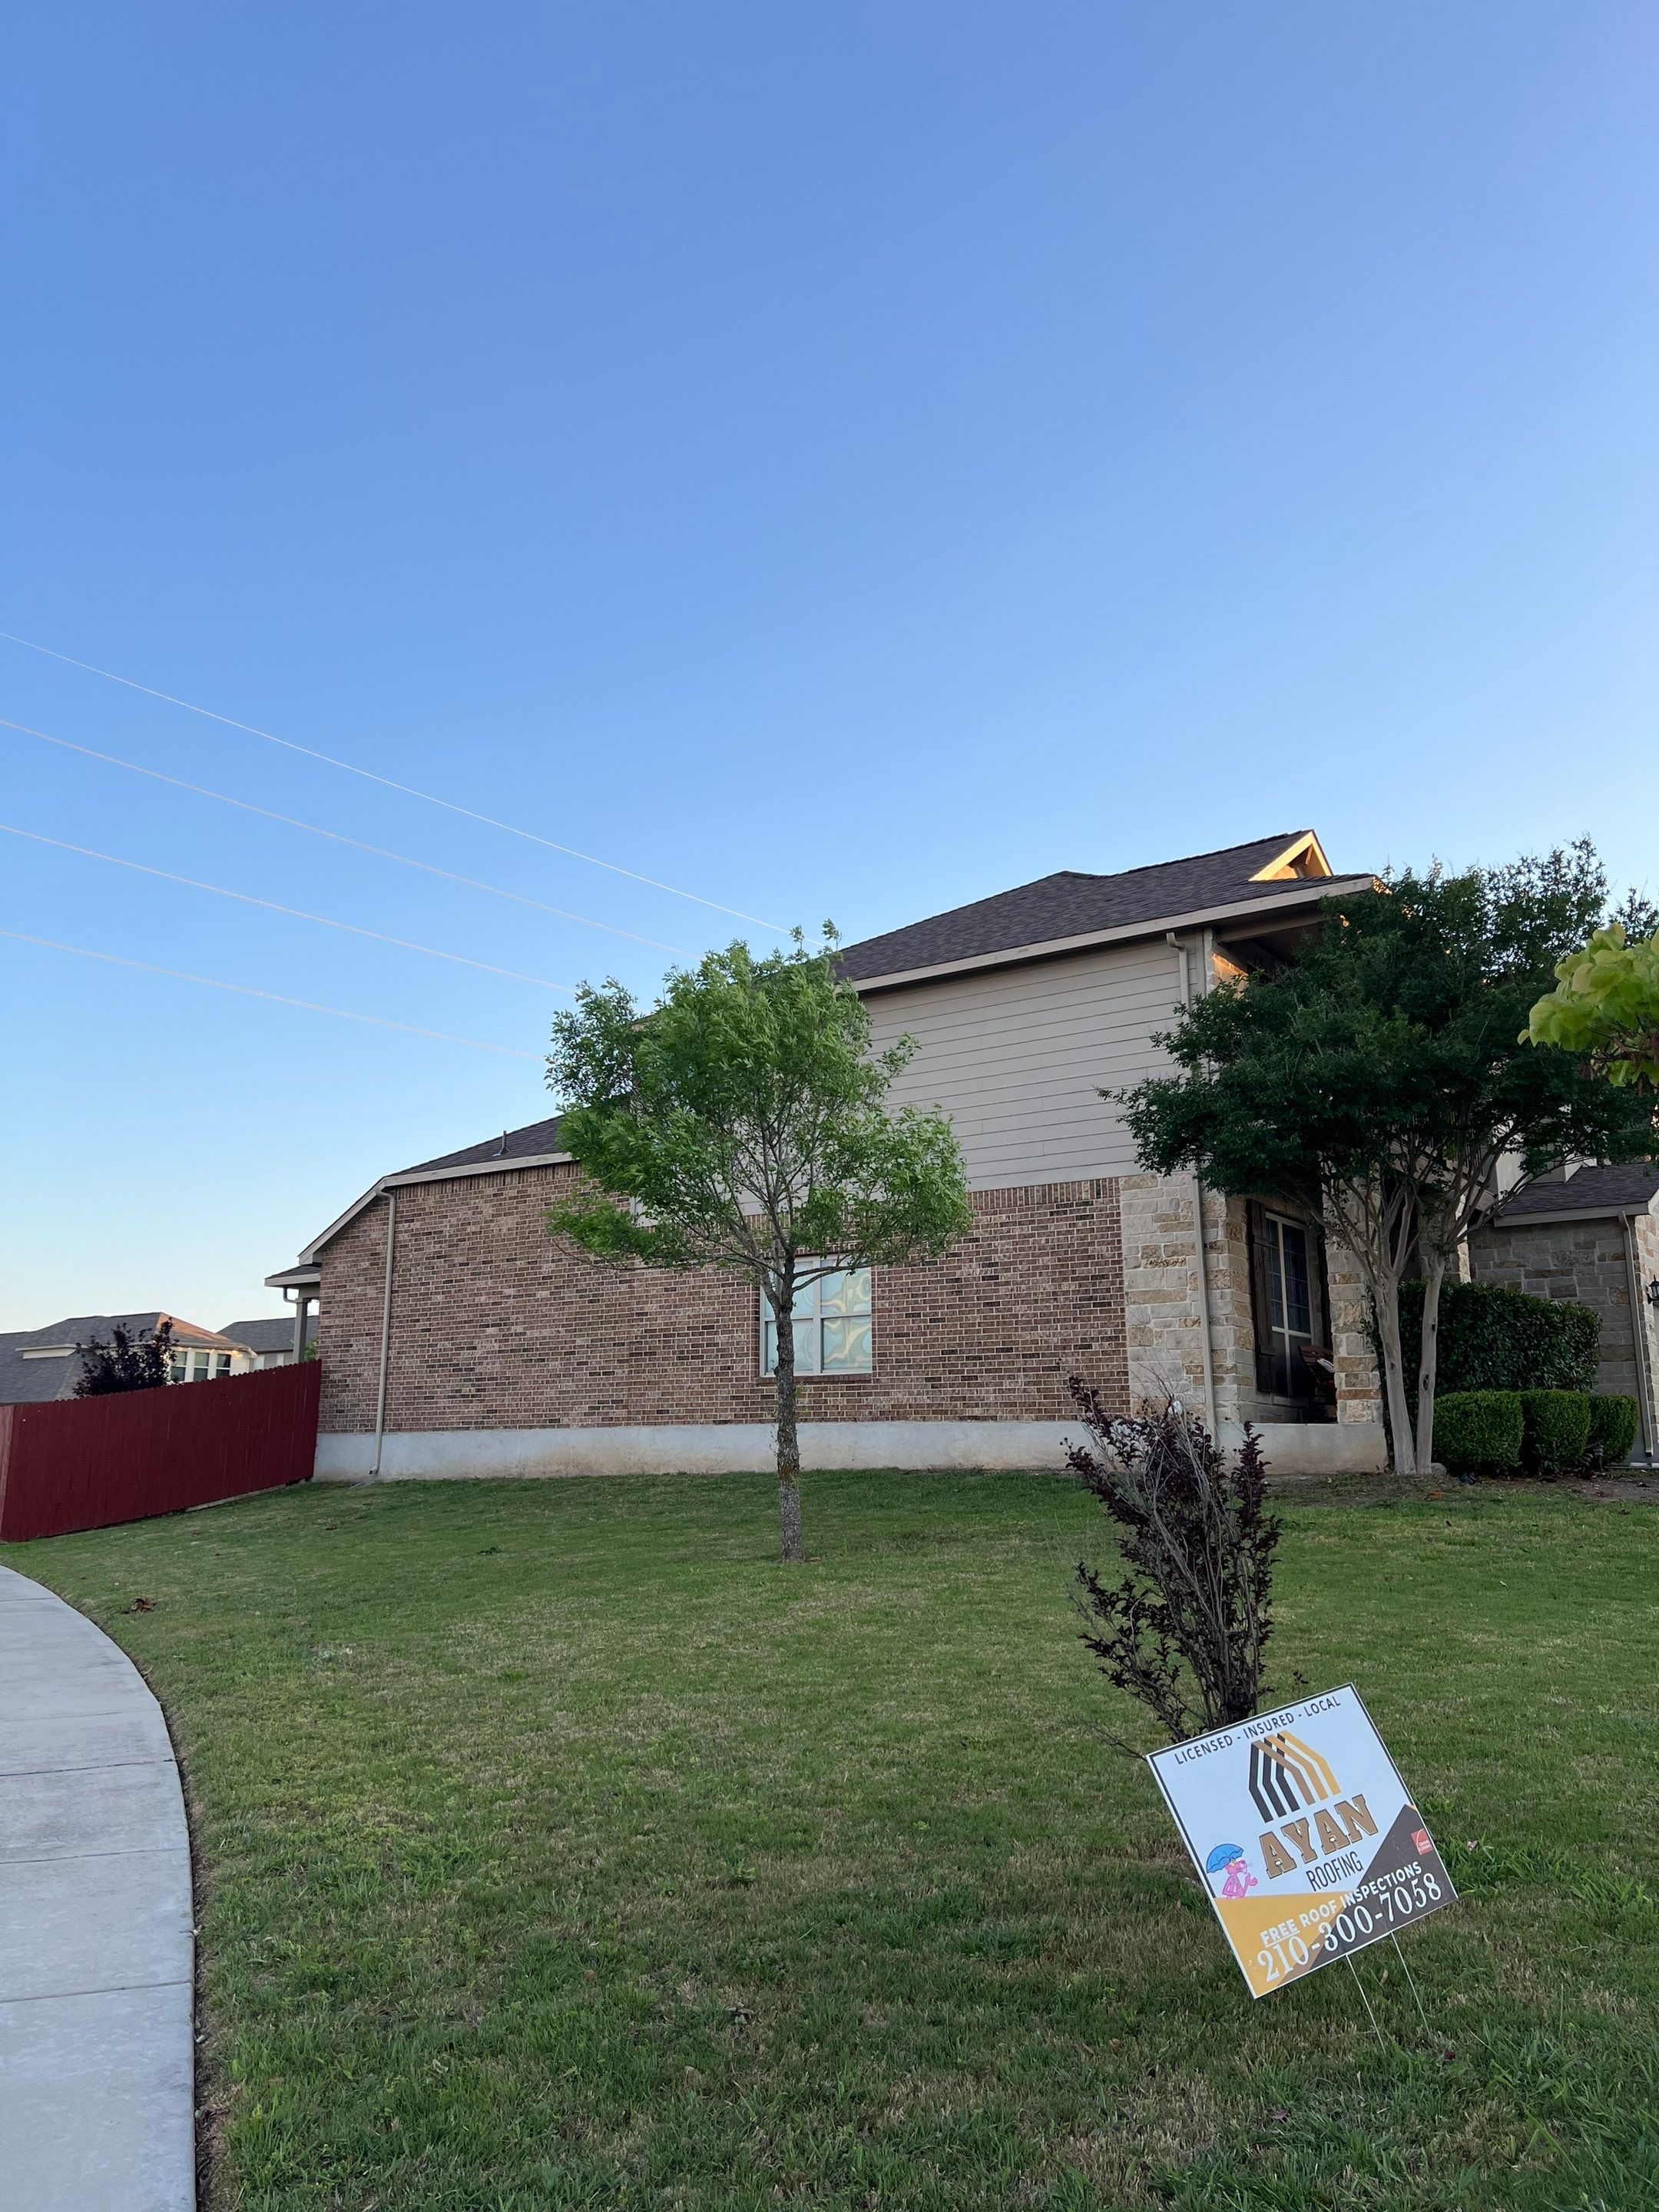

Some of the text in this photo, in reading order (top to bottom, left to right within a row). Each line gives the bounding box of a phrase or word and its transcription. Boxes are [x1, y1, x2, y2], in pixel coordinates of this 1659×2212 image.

[1175, 1734, 1233, 1764] LICENSED
[1243, 1712, 1295, 1739] INSURED
[1304, 1696, 1341, 1717] LOCAL
[1258, 1793, 1379, 1879] AYAN
[1305, 1850, 1364, 1892] ROOFING
[1257, 1873, 1442, 1982] 210-300-7058
[1260, 1861, 1422, 1946] FREE ROOF INSPECTIONS
